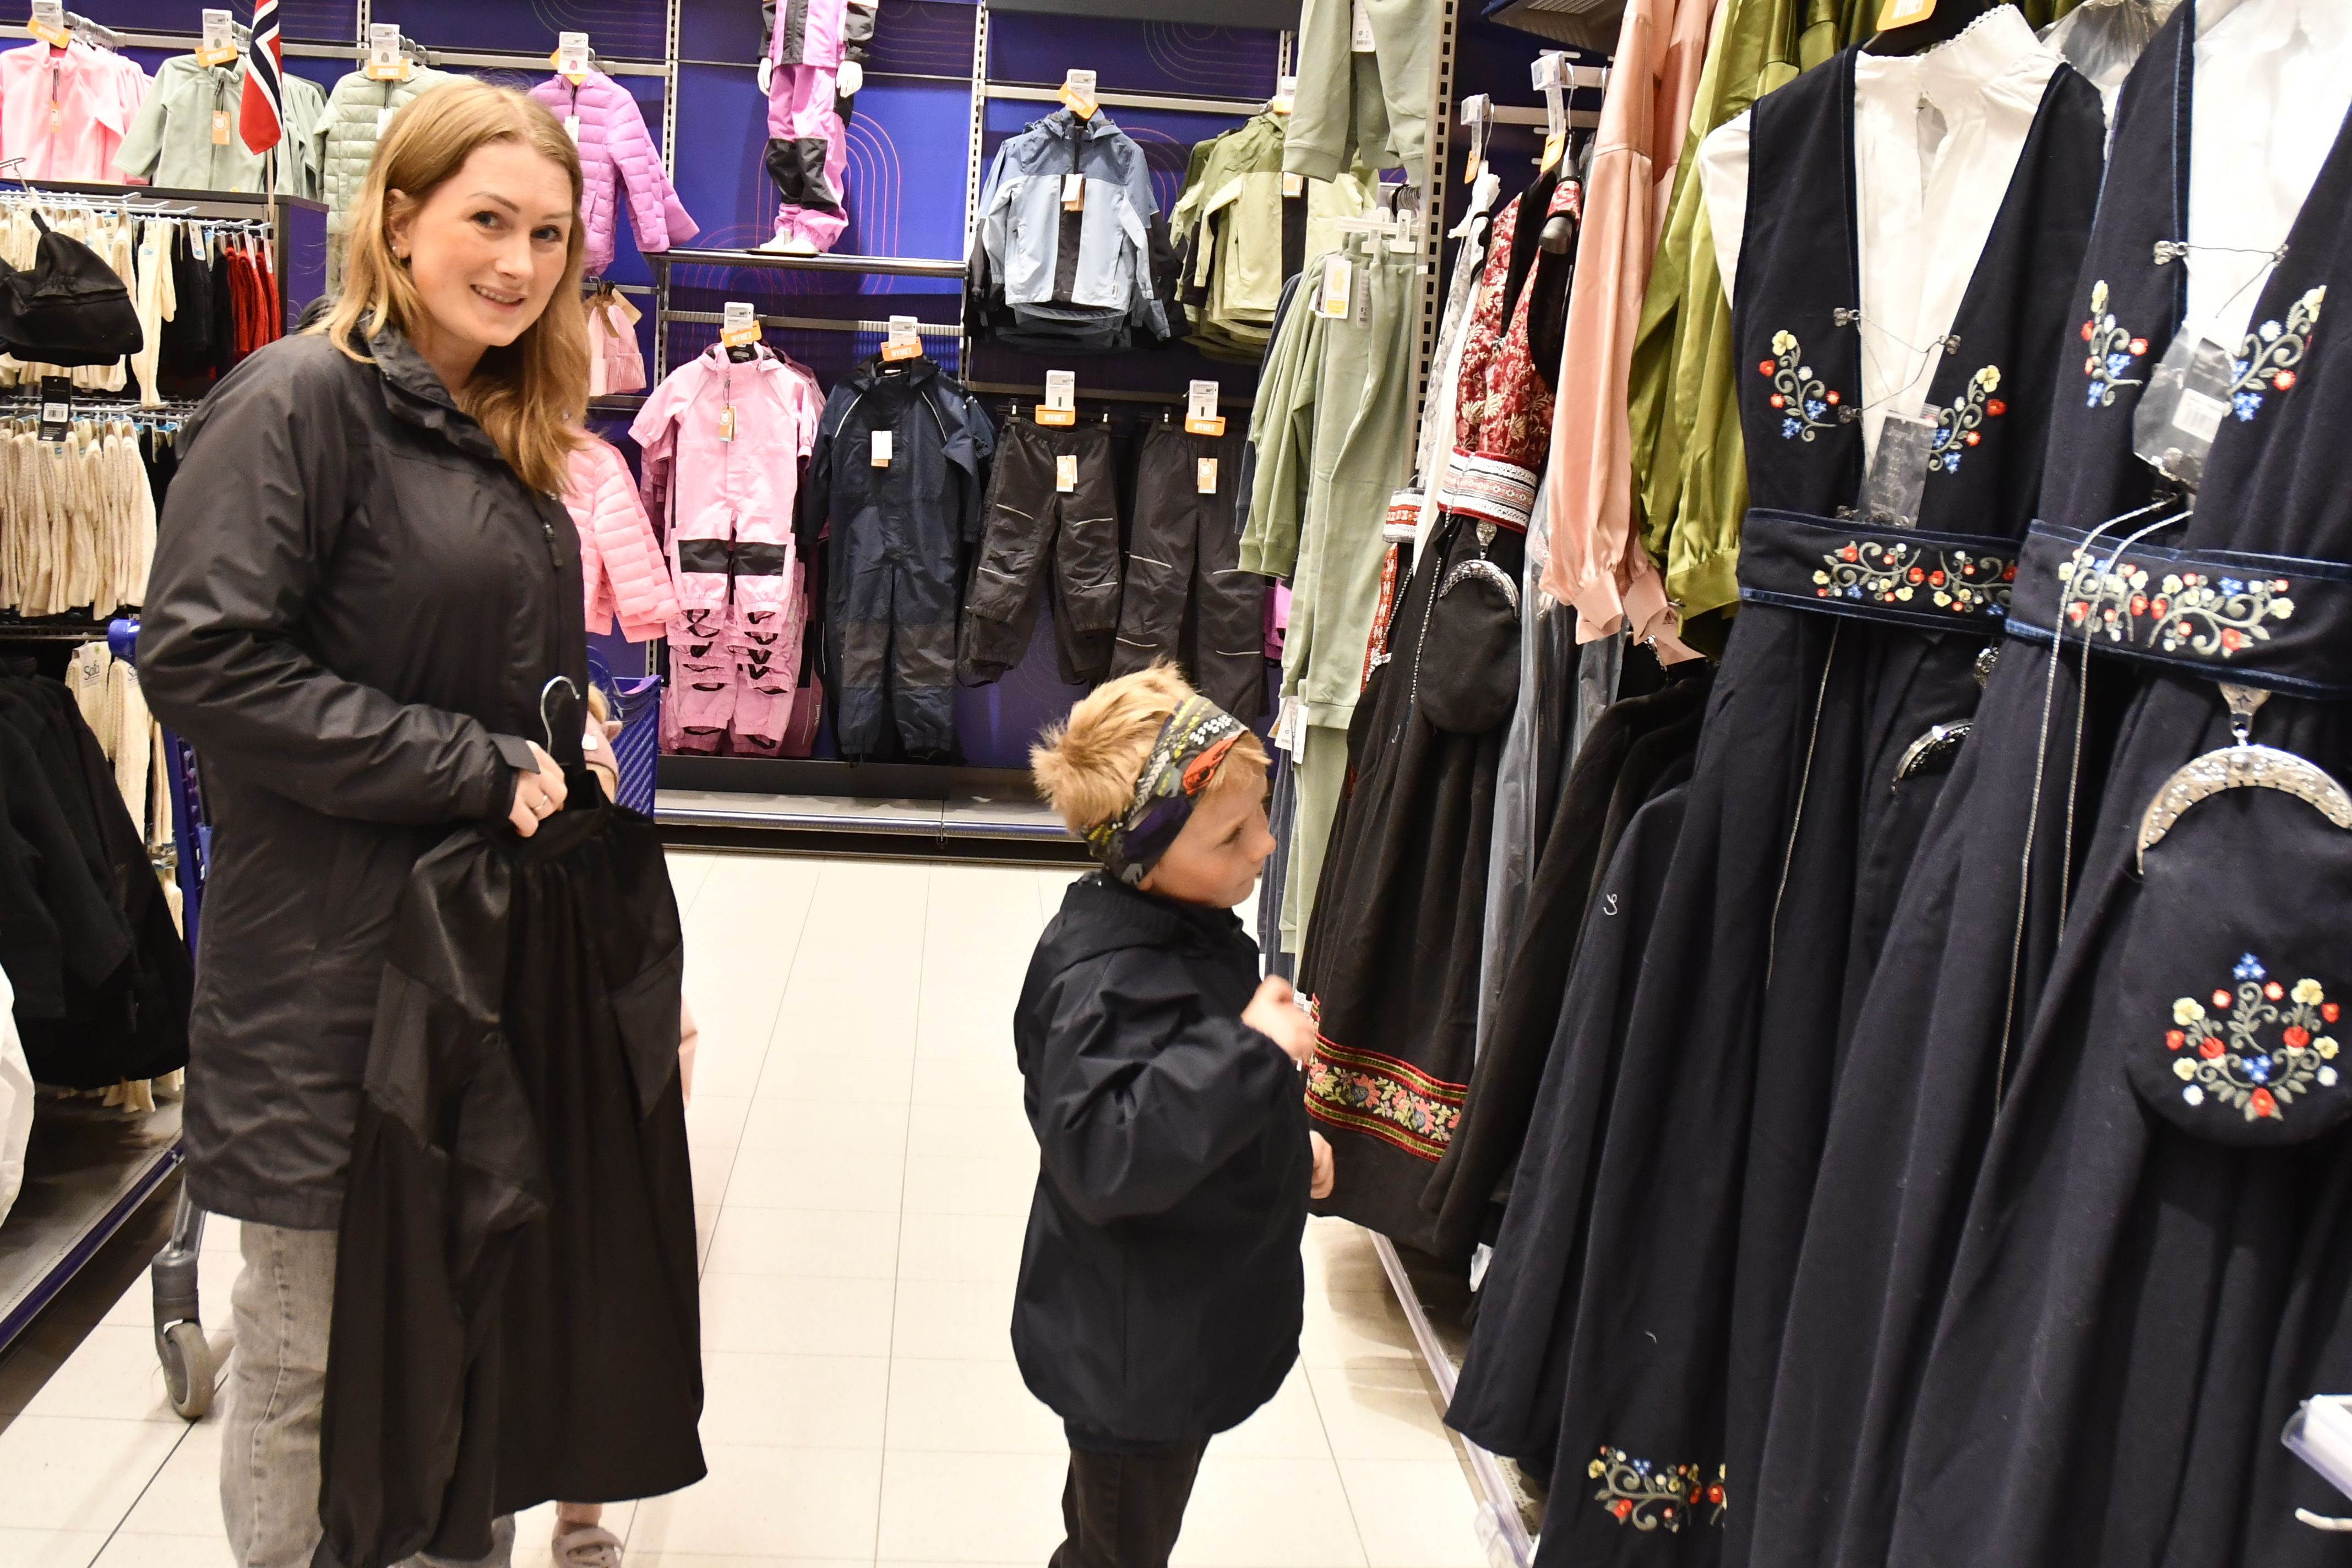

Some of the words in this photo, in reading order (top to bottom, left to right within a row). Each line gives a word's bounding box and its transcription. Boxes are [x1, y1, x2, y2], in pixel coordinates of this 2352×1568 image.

[731, 331, 752, 343] NYHET
[891, 347, 912, 357] NYHET
[1194, 422, 1215, 432] NYHET
[84, 660, 100, 680] Safa
